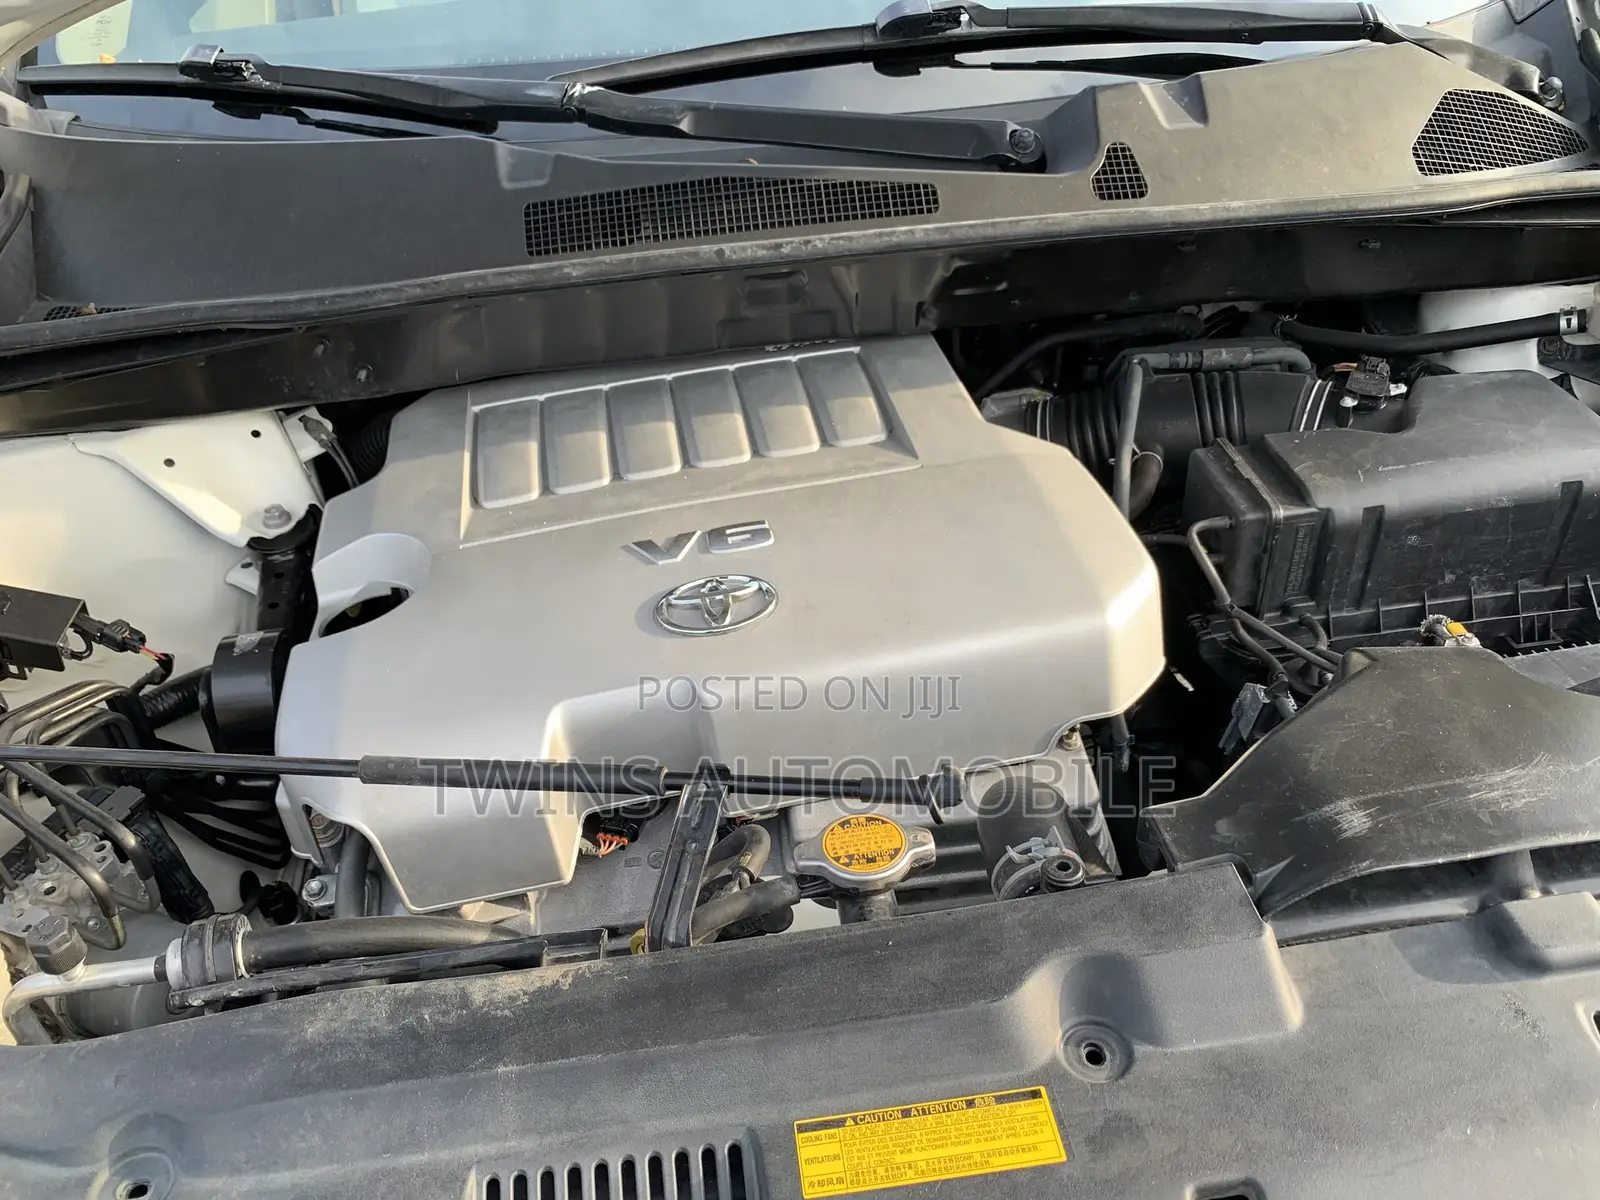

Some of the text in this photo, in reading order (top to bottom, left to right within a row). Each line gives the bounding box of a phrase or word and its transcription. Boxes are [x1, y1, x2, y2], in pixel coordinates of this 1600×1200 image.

[629, 520, 775, 565] V6
[844, 819, 882, 830] CAUTION
[853, 848, 895, 860] ATTENTION
[857, 1100, 967, 1124] CAUTION ATTENTION
[800, 1131, 837, 1144] COOLING FANS
[804, 1153, 841, 1165] VENTILATEURS
[807, 1176, 844, 1189] 冷却风扇
